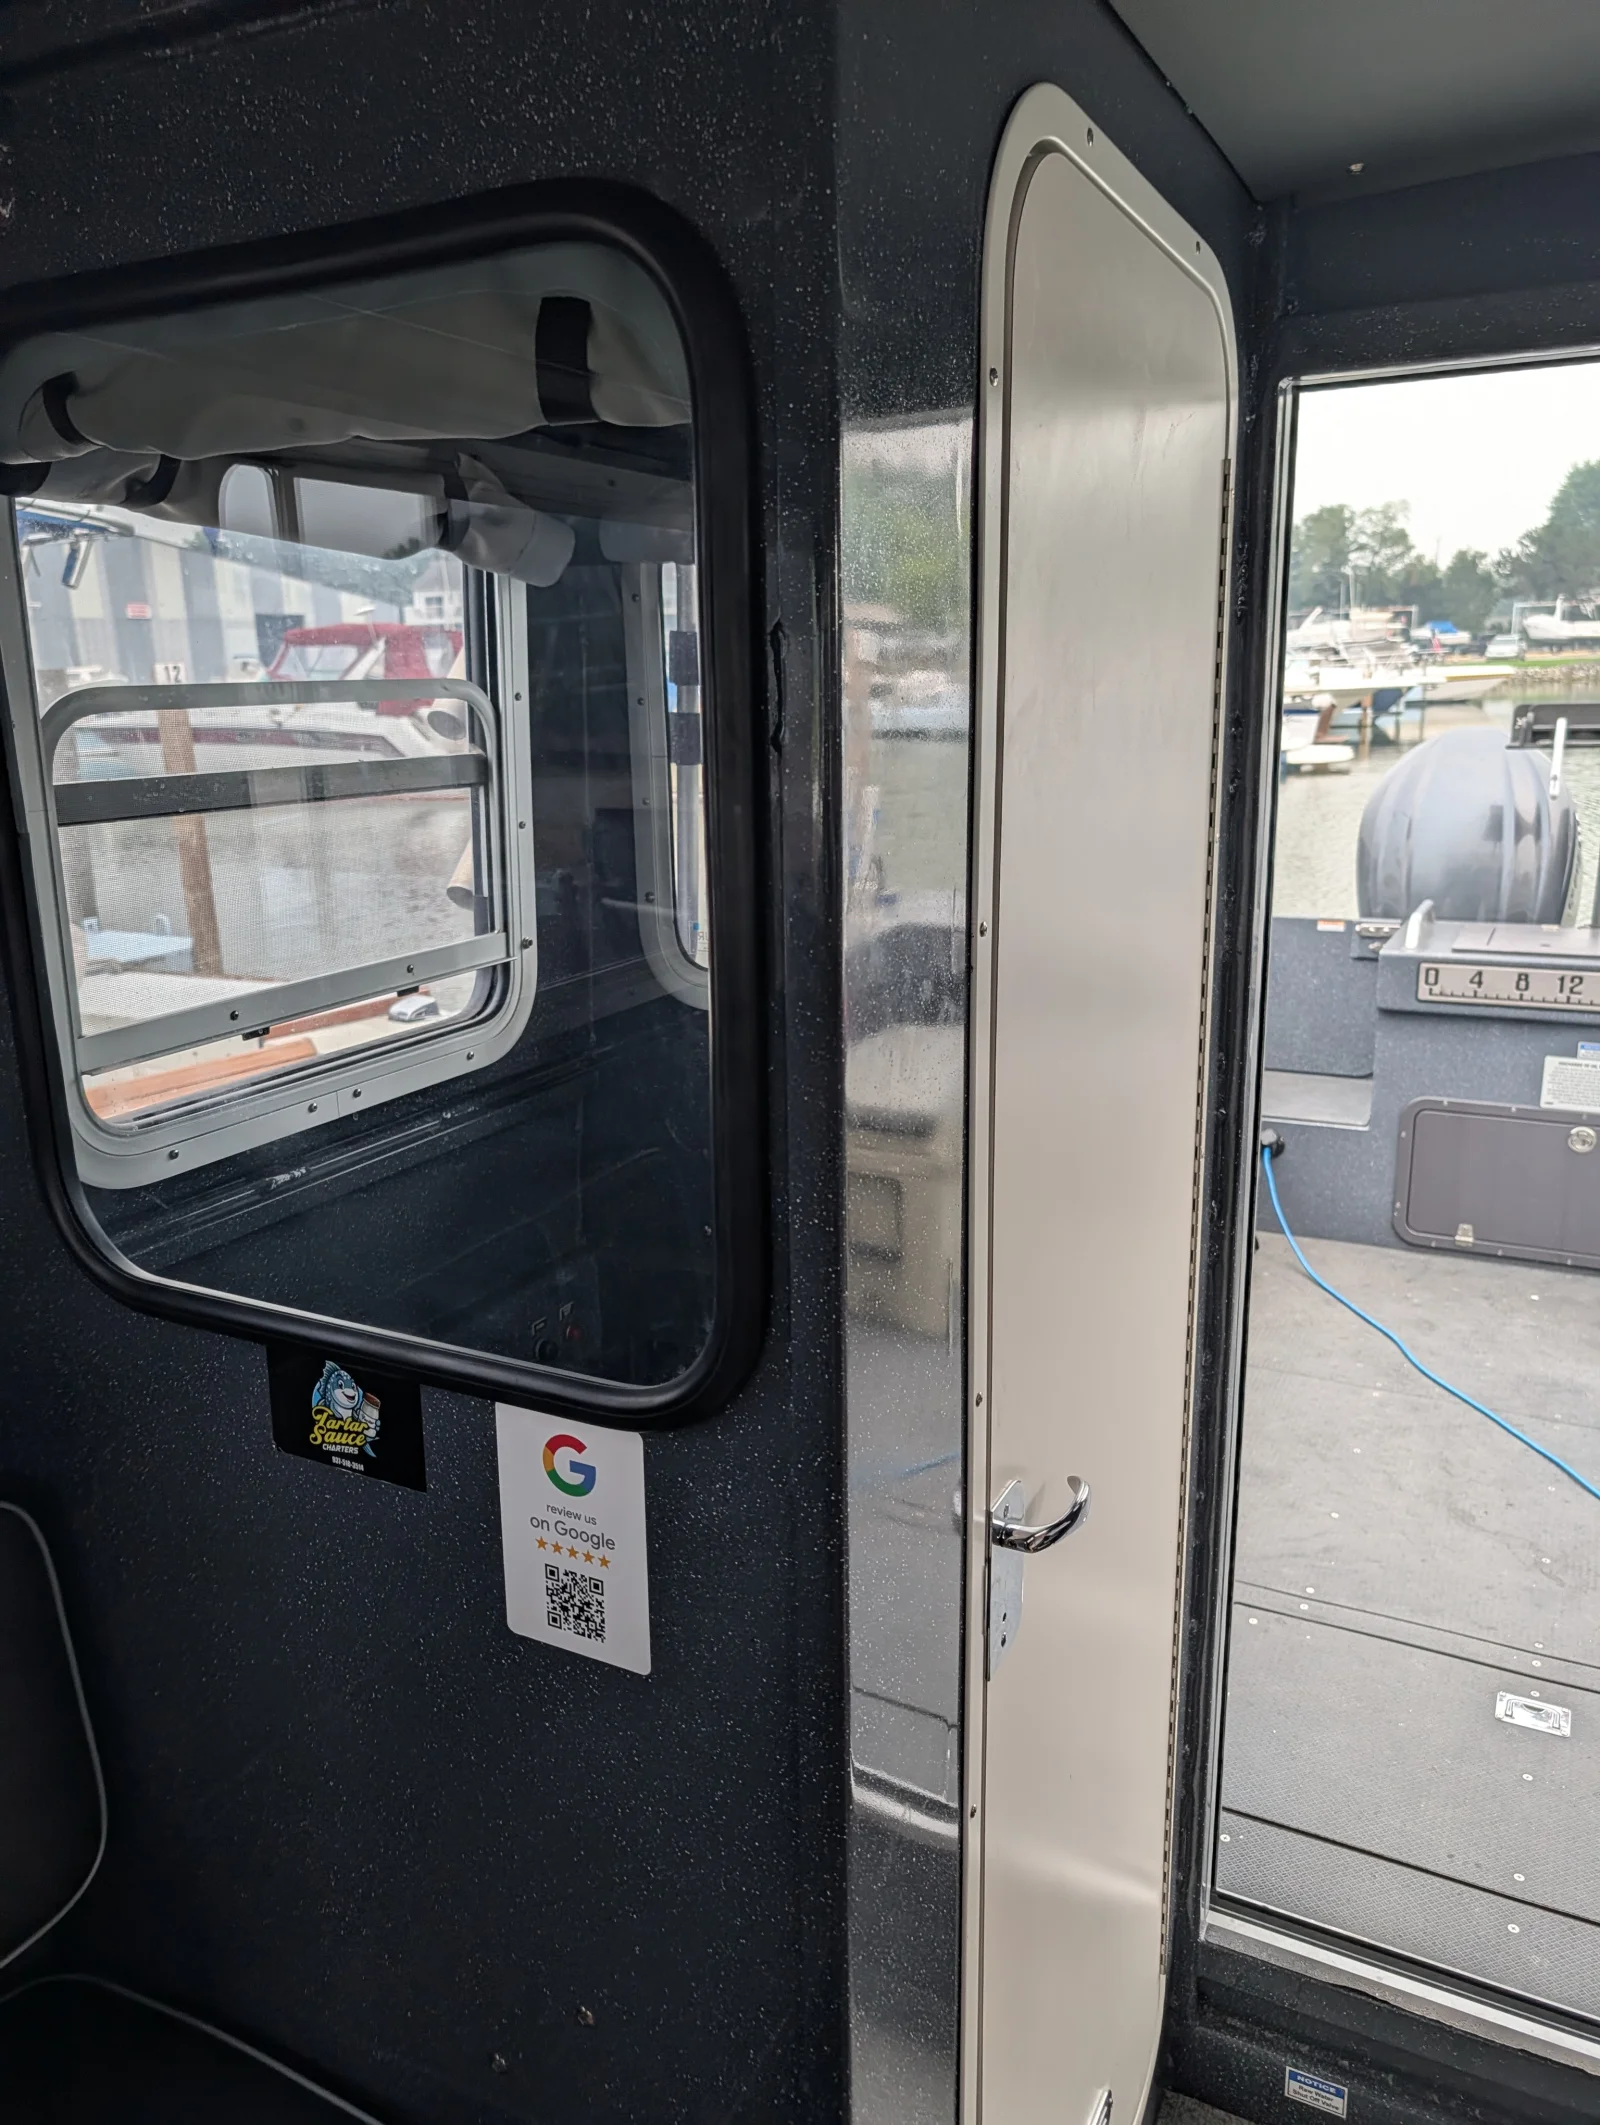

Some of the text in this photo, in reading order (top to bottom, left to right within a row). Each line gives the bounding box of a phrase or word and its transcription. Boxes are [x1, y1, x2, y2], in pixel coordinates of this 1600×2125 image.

[164, 665, 182, 683] 12
[1424, 967, 1584, 995] 0 4 8 12
[312, 1406, 369, 1432] Tartar
[309, 1424, 366, 1446] Sauce
[322, 1443, 359, 1454] CHARTERS
[542, 1434, 597, 1497] G
[546, 1504, 598, 1526] review us
[530, 1516, 616, 1550] on Google
[1297, 2075, 1337, 2094] NOTICE
[1298, 2085, 1334, 2102] Raw Water
[1292, 2088, 1340, 2111] Shut Off Valve
